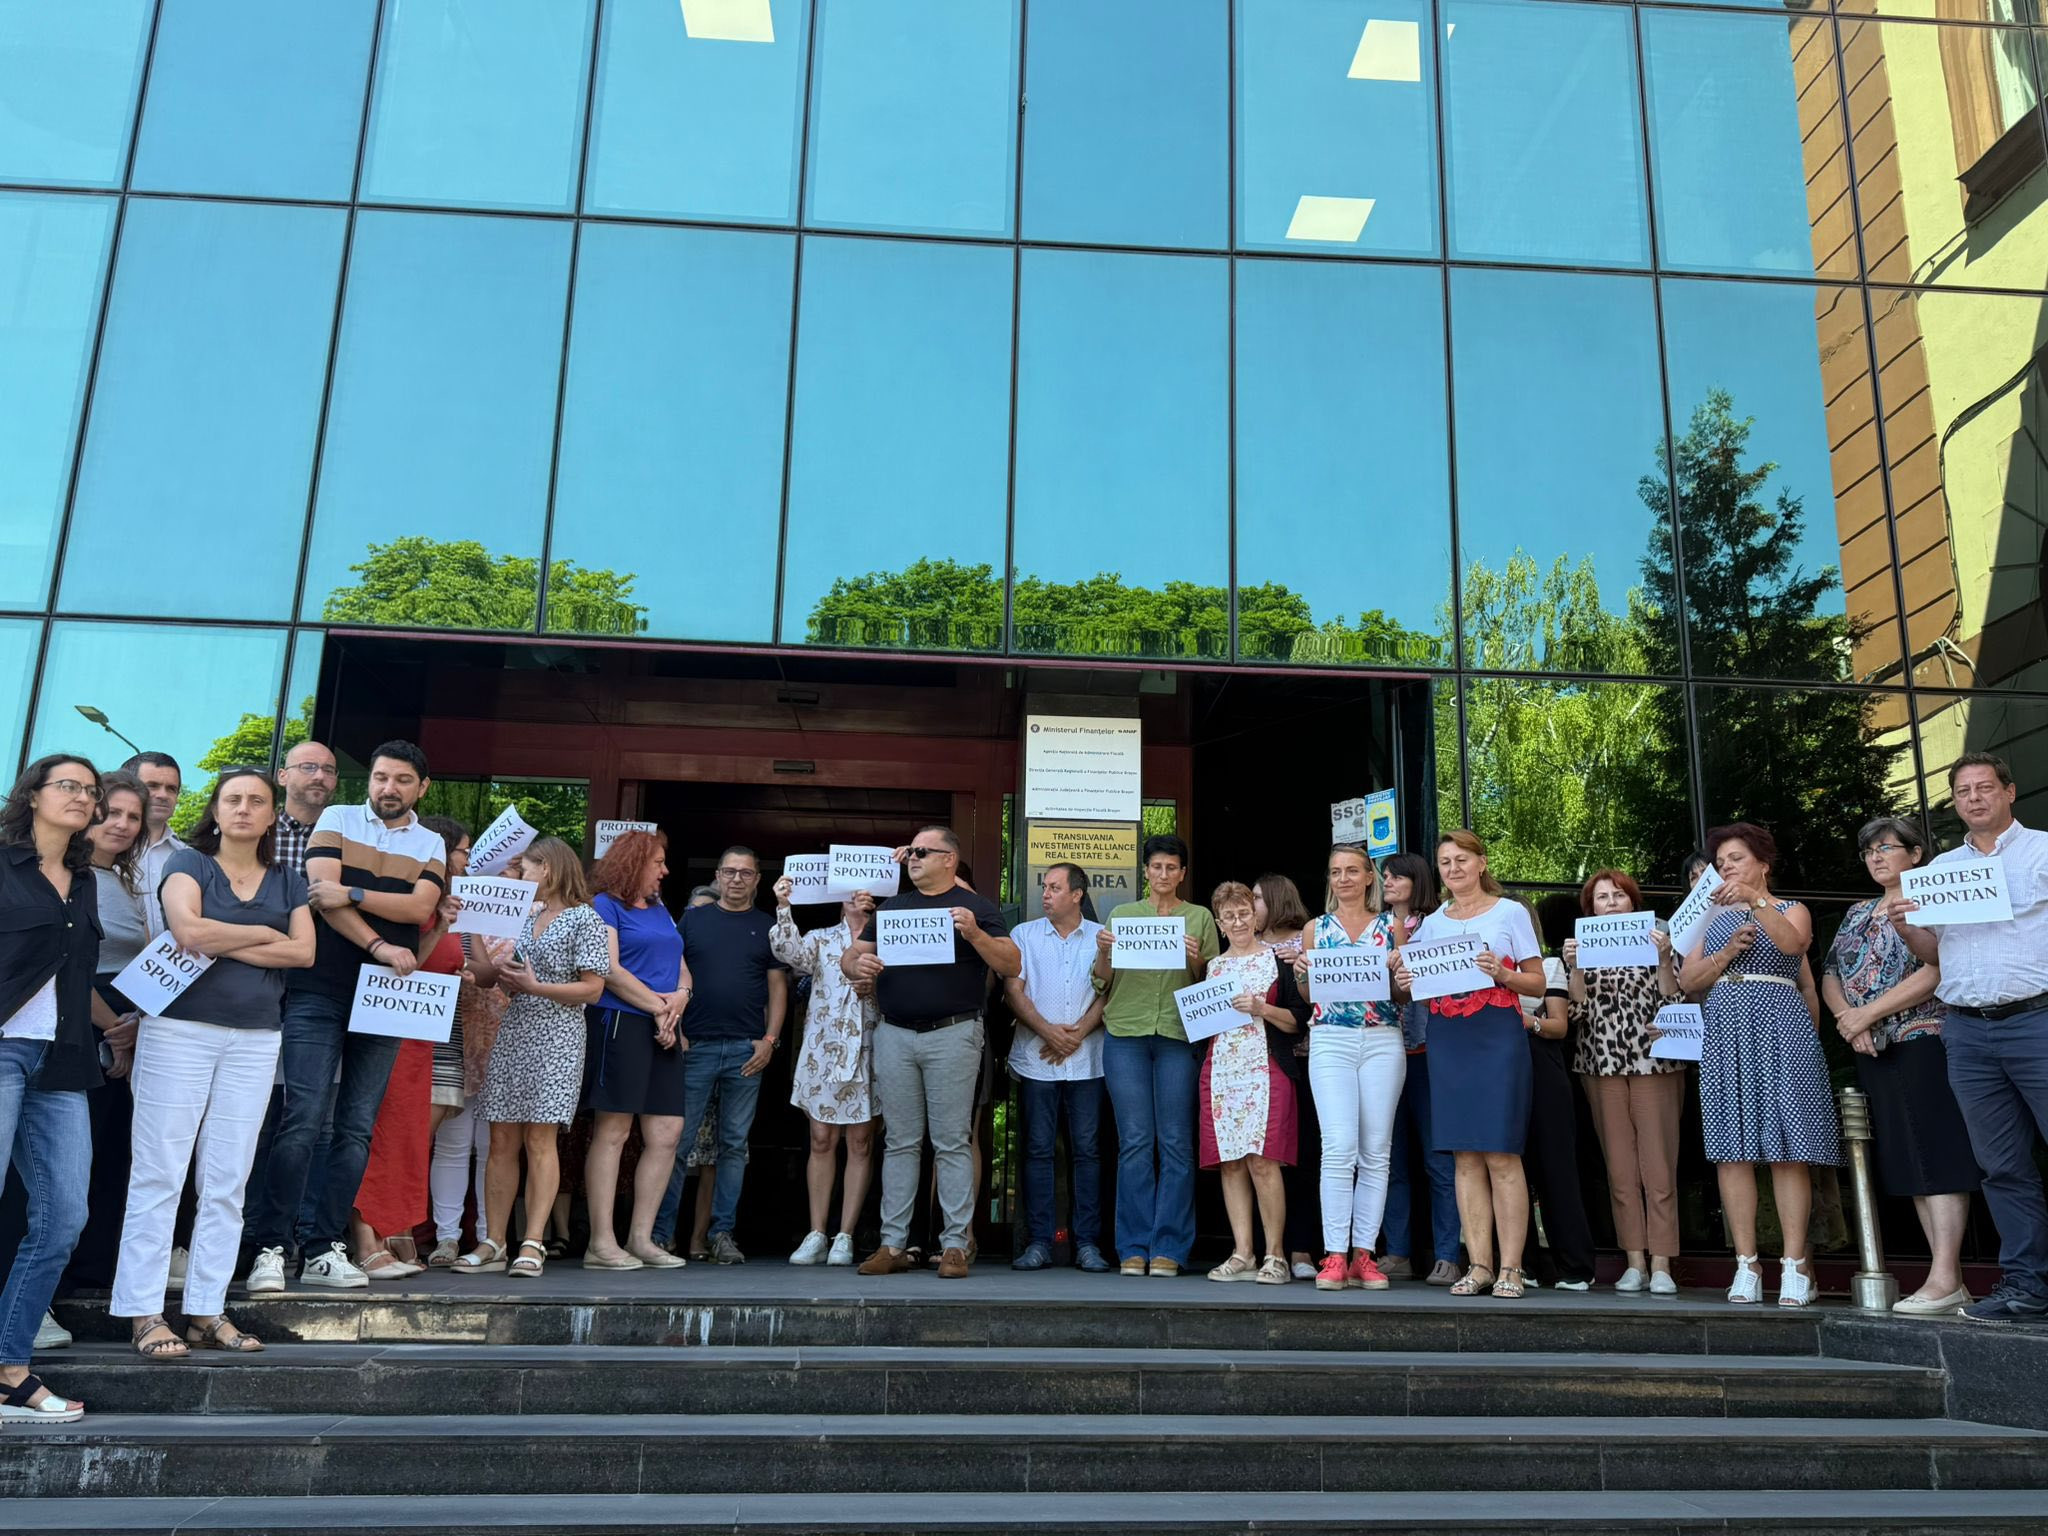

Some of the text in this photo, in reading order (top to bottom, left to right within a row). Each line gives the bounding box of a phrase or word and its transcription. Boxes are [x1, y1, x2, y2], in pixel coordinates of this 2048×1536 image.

[1043, 726, 1077, 734] Ministerul
[1332, 803, 1365, 821] SSG
[600, 822, 652, 832] PROTEST
[1052, 833, 1114, 841] TRANSILVANIA
[471, 828, 526, 873] SPONTAN
[1030, 842, 1136, 852] INVESTMENTS ALLIANCE
[835, 852, 894, 865] PROTEST
[1045, 851, 1122, 860] REAL ESTATE S.A.
[788, 862, 829, 872] PROTE
[833, 866, 894, 879] SPONTAN
[1909, 867, 1994, 890] PROTEST
[459, 883, 528, 901] PROTEST
[1673, 875, 1712, 928] PROTEST
[883, 916, 947, 930] PROTEST
[1674, 896, 1714, 938] SPONTA
[1117, 924, 1178, 936] PROTEST
[1582, 919, 1648, 934] PROTEST
[882, 932, 948, 946] SPONTAN
[1117, 939, 1178, 950] SPONTAN
[1581, 935, 1649, 949] SPONTAN
[1407, 940, 1476, 963] PROTEST
[155, 942, 204, 979] PROT
[1313, 954, 1381, 969] PROTEST
[139, 958, 187, 996] SPON
[1314, 971, 1382, 984] SPONTAN
[367, 974, 451, 998] PROTEST
[1180, 980, 1235, 1007] PROTEST
[361, 993, 446, 1017] SPONTAN
[1185, 997, 1233, 1022] SPONTA
[1655, 1012, 1697, 1024] PROTEST
